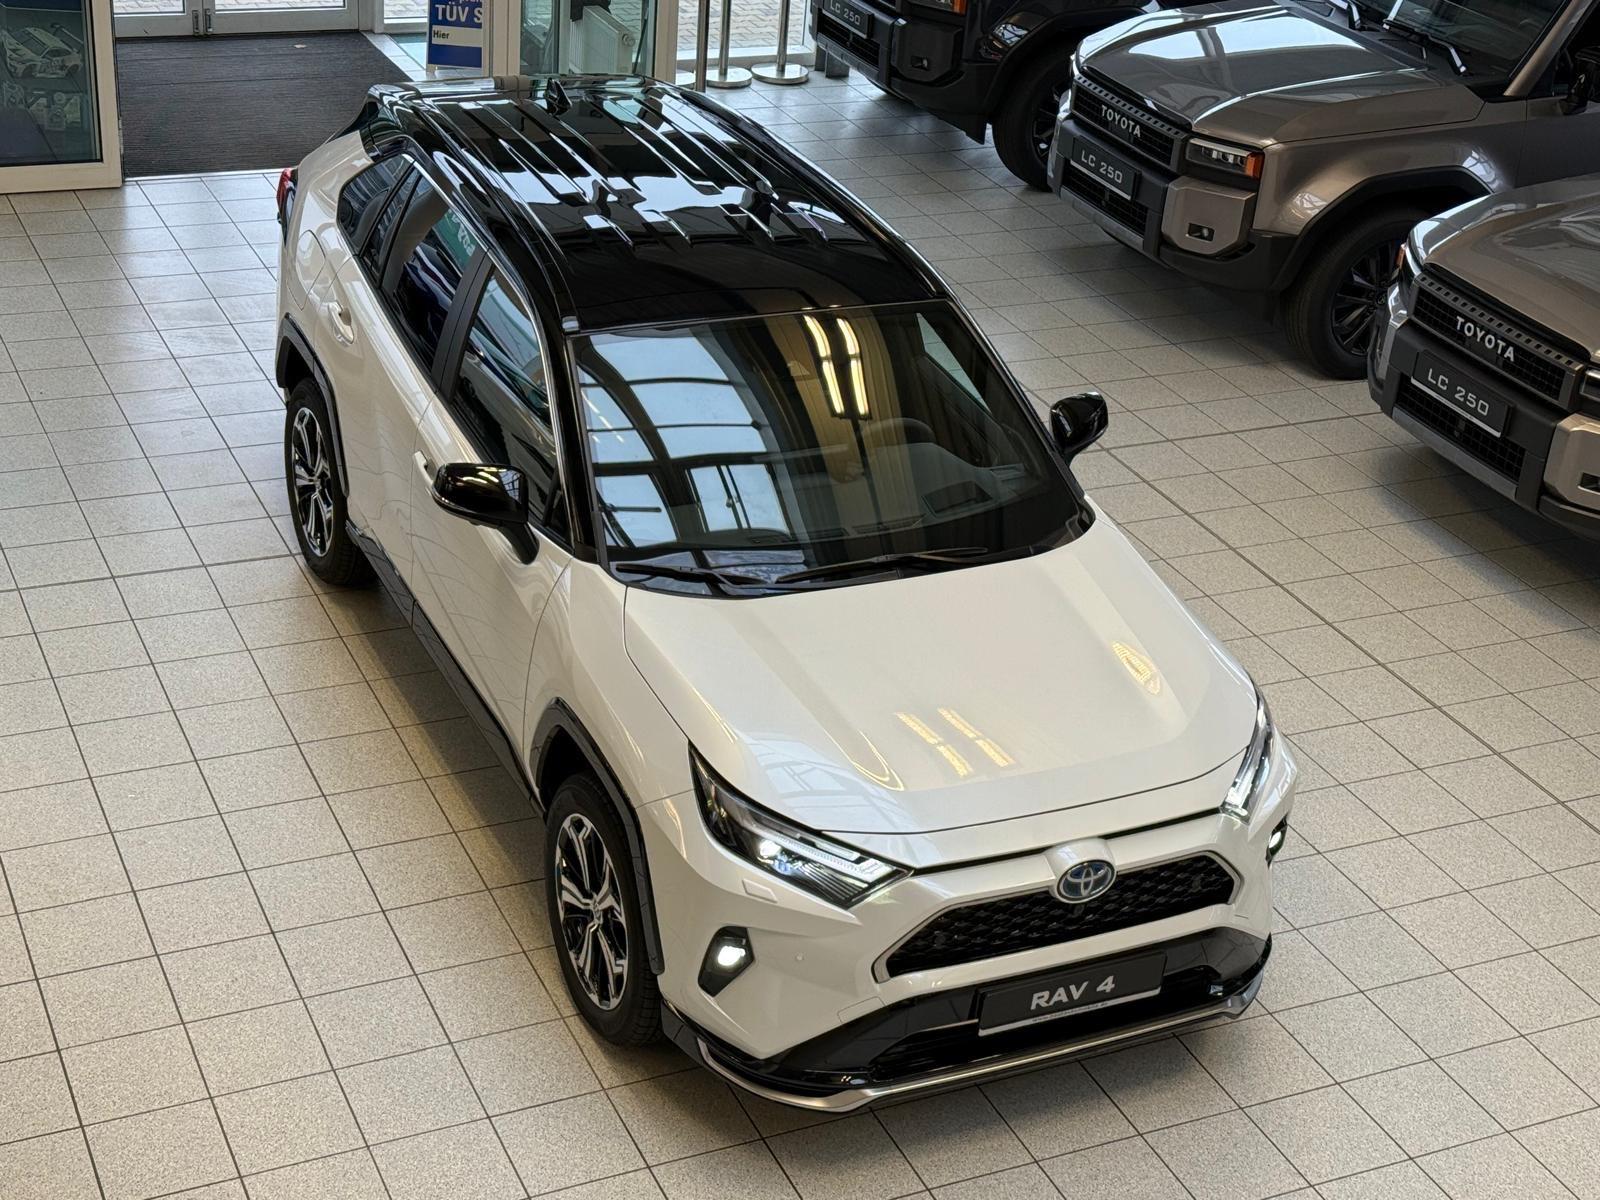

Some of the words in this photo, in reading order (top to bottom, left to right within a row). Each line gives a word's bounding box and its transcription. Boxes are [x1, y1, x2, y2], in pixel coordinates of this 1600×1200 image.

[435, 1, 469, 22] TÜV
[843, 8, 861, 26] 250
[433, 29, 450, 39] Hier
[1101, 104, 1141, 138] TOYOTA
[1081, 150, 1096, 167] LC
[1099, 162, 1123, 184] 250
[1456, 315, 1515, 362] TOYOTA
[1427, 368, 1449, 391] LC
[1454, 386, 1490, 416] 250
[1030, 981, 1089, 1011] RAV
[1096, 975, 1116, 993] 4
